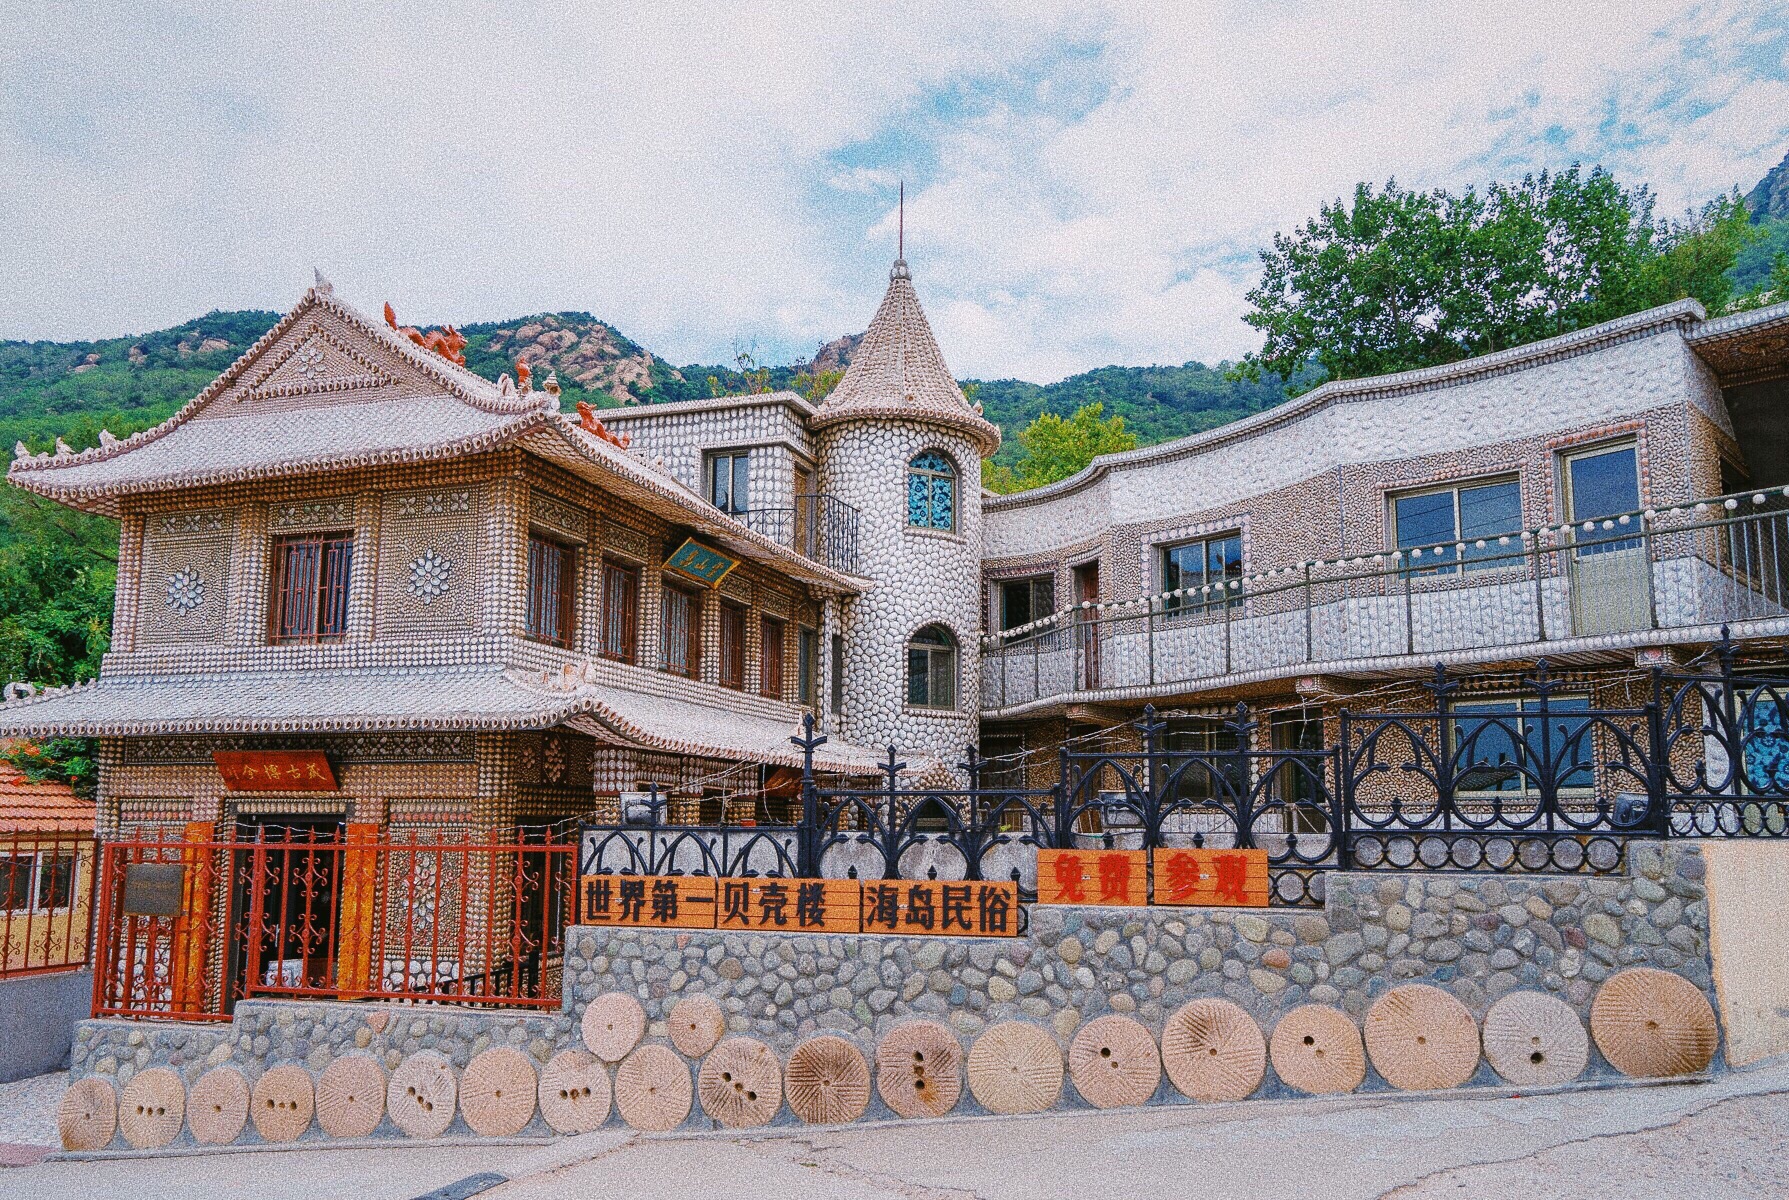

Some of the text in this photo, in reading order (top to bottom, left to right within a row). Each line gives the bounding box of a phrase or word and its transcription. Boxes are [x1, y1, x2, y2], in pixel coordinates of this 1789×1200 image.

[1053, 852, 1248, 903] 免费 参观
[586, 880, 1010, 932] 世界第一 贝壳楼 海岛民俗
